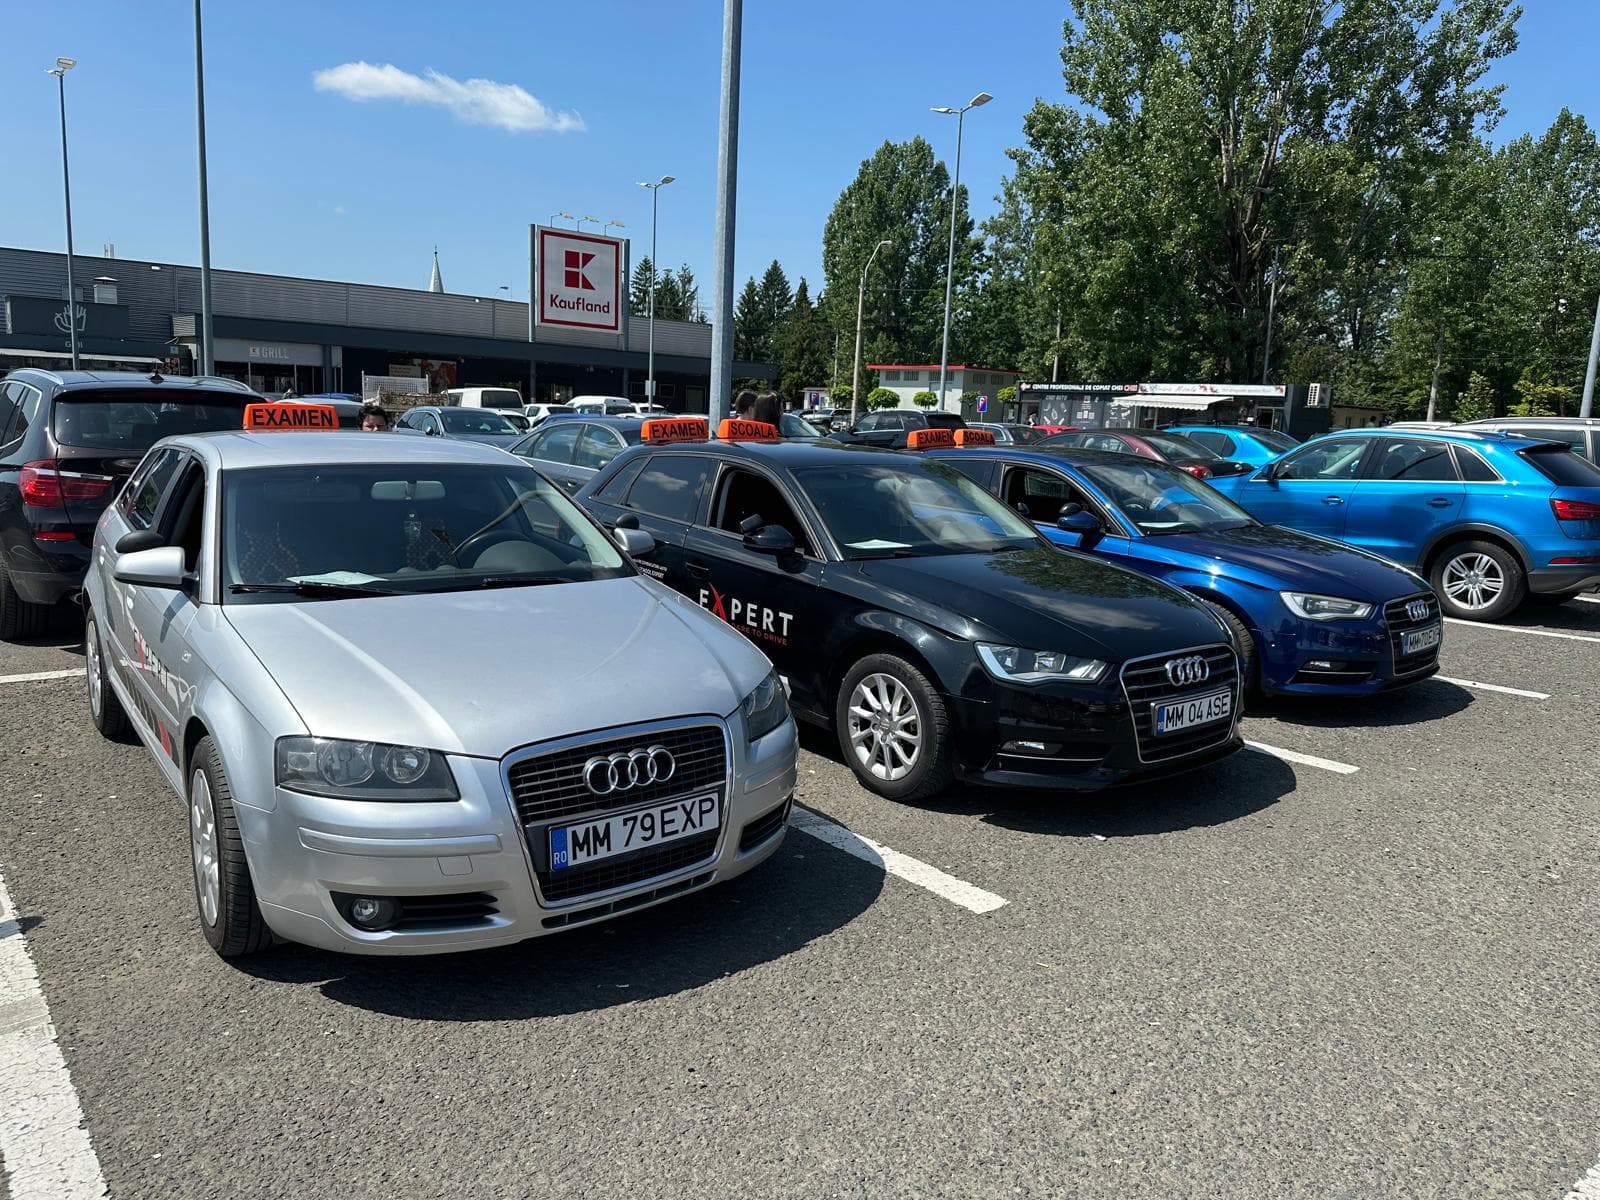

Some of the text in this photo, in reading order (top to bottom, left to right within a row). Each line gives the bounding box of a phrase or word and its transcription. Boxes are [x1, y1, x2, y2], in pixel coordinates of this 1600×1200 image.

[550, 294, 610, 314] Kaufland
[261, 347, 289, 359] GRILL
[252, 408, 333, 427] EXAMEN
[651, 421, 705, 439] EXAMEN
[731, 422, 775, 438] SCOALA
[918, 431, 954, 445] EXAMEN
[964, 431, 996, 445] SCOALA
[700, 582, 793, 637] EXPERT
[752, 628, 762, 637] TO
[763, 633, 788, 646] DRIVE
[1165, 694, 1230, 729] MM 04 ASE
[571, 822, 612, 861] MM
[553, 850, 567, 865] RO
